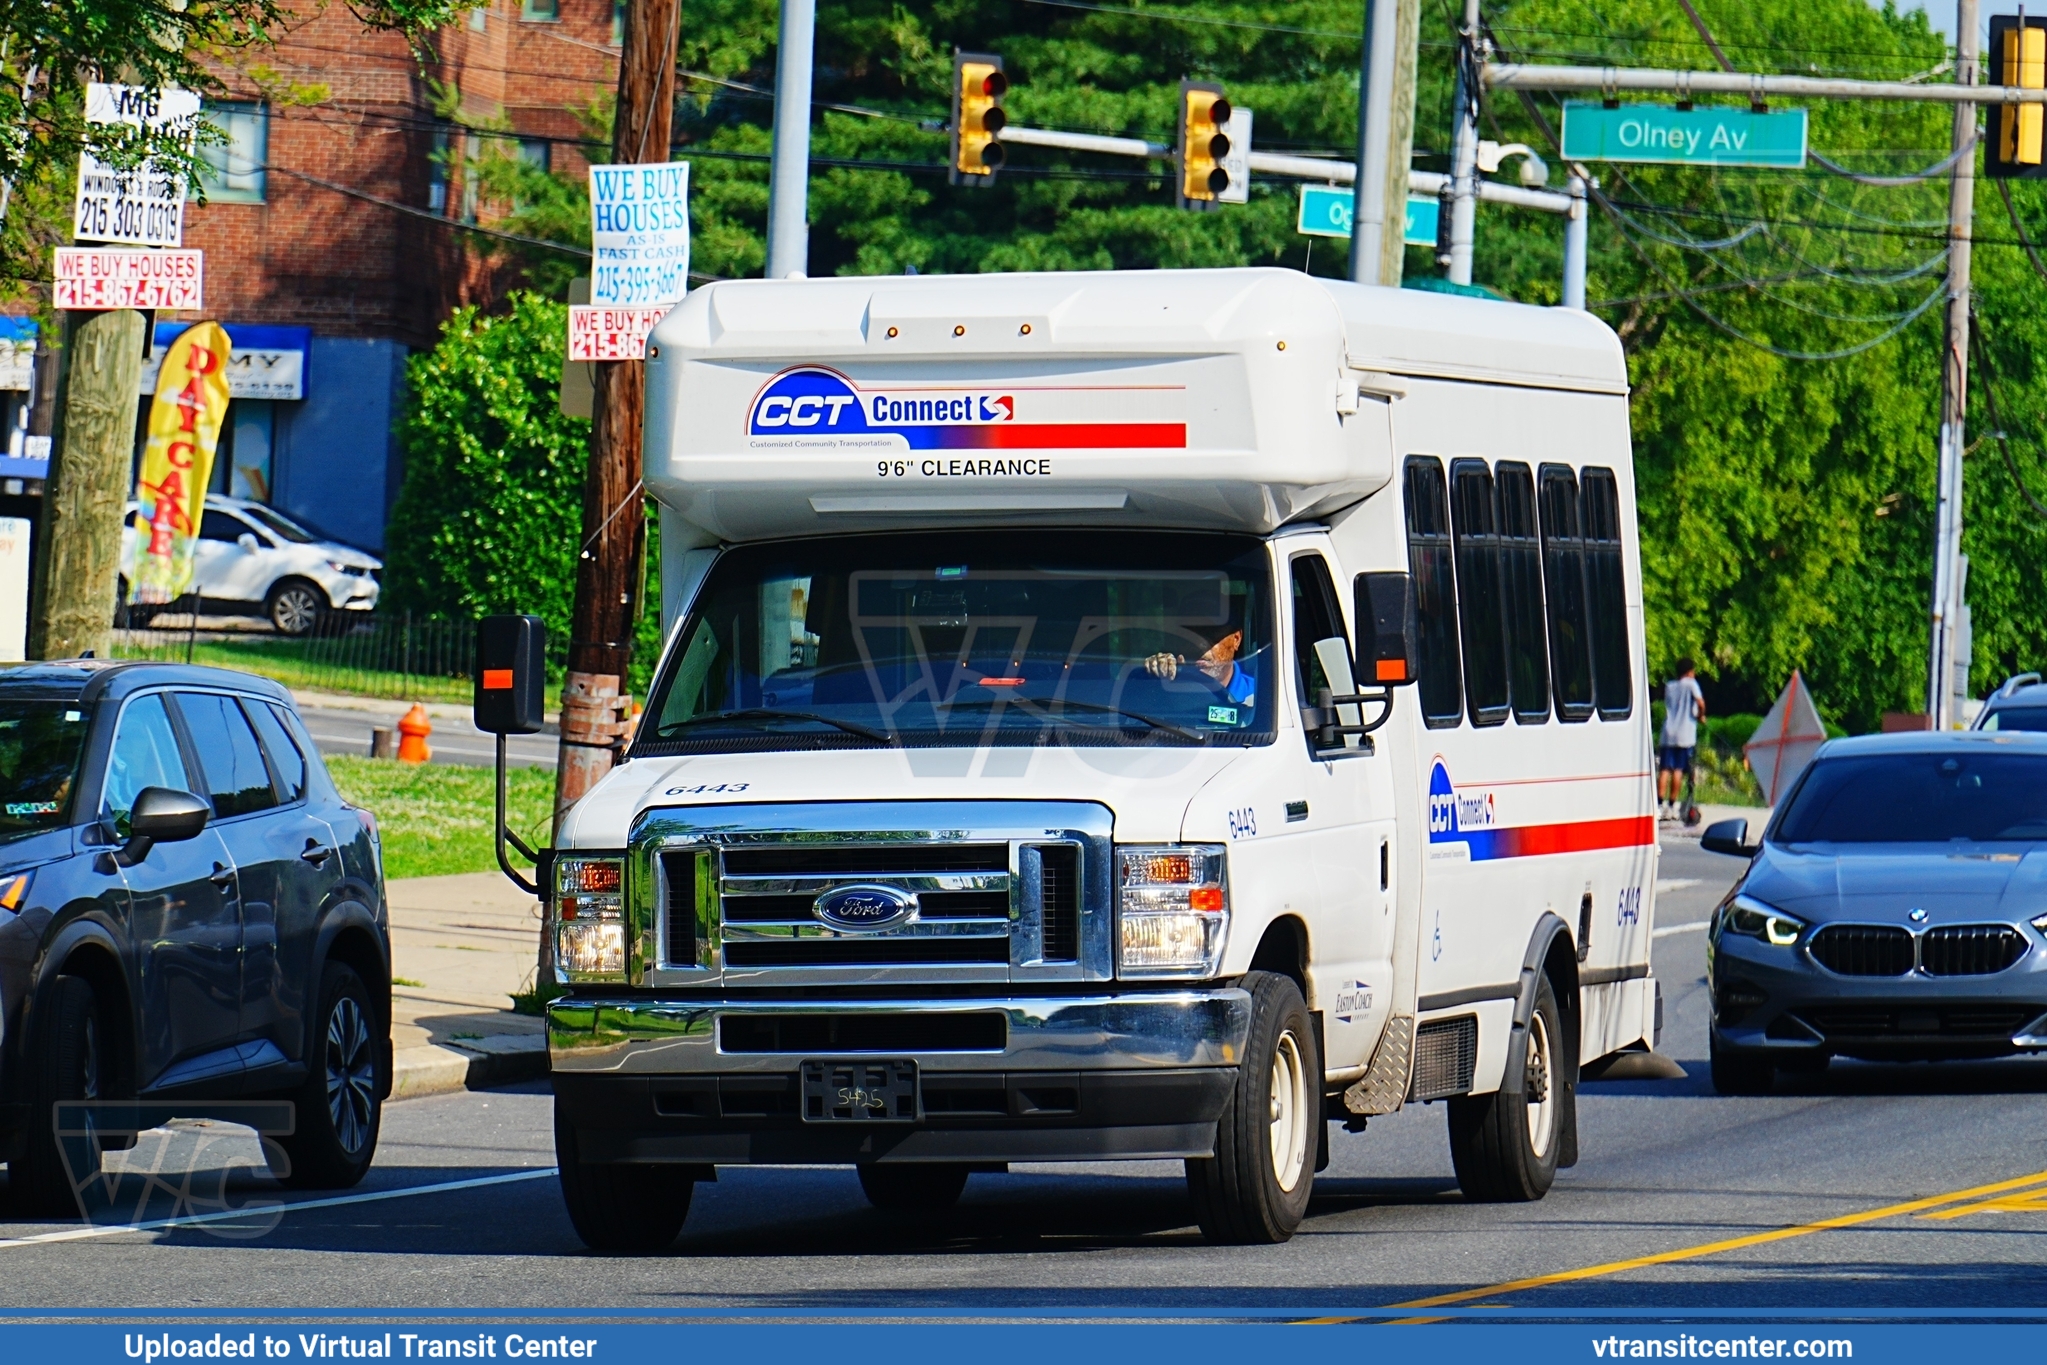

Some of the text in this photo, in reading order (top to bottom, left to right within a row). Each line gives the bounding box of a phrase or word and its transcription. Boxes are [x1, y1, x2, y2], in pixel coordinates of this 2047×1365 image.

[1619, 119, 1747, 156] Olney Av
[83, 175, 134, 196] WINDOS
[594, 167, 684, 202] WE BUY
[80, 197, 178, 242] 215 303 0319
[595, 200, 684, 233] HOUSES
[599, 245, 685, 260] FAST CASH
[61, 255, 195, 278] WE BUY HOUSES
[59, 280, 197, 307] 215-867-6762
[597, 260, 683, 303] 215-395-3667
[575, 312, 602, 332] WE
[605, 311, 636, 332] BUY
[756, 395, 972, 427] CCT Connect
[750, 440, 892, 448] Customized Community Transportation
[877, 459, 1051, 477] 9'6" CLEARANCE
[665, 783, 750, 796] 6443
[1228, 807, 1257, 839] 6443
[1429, 793, 1484, 833] CCT Connect
[840, 896, 884, 915] Ford
[1617, 886, 1641, 927] 6443
[838, 1086, 884, 1108] 5425
